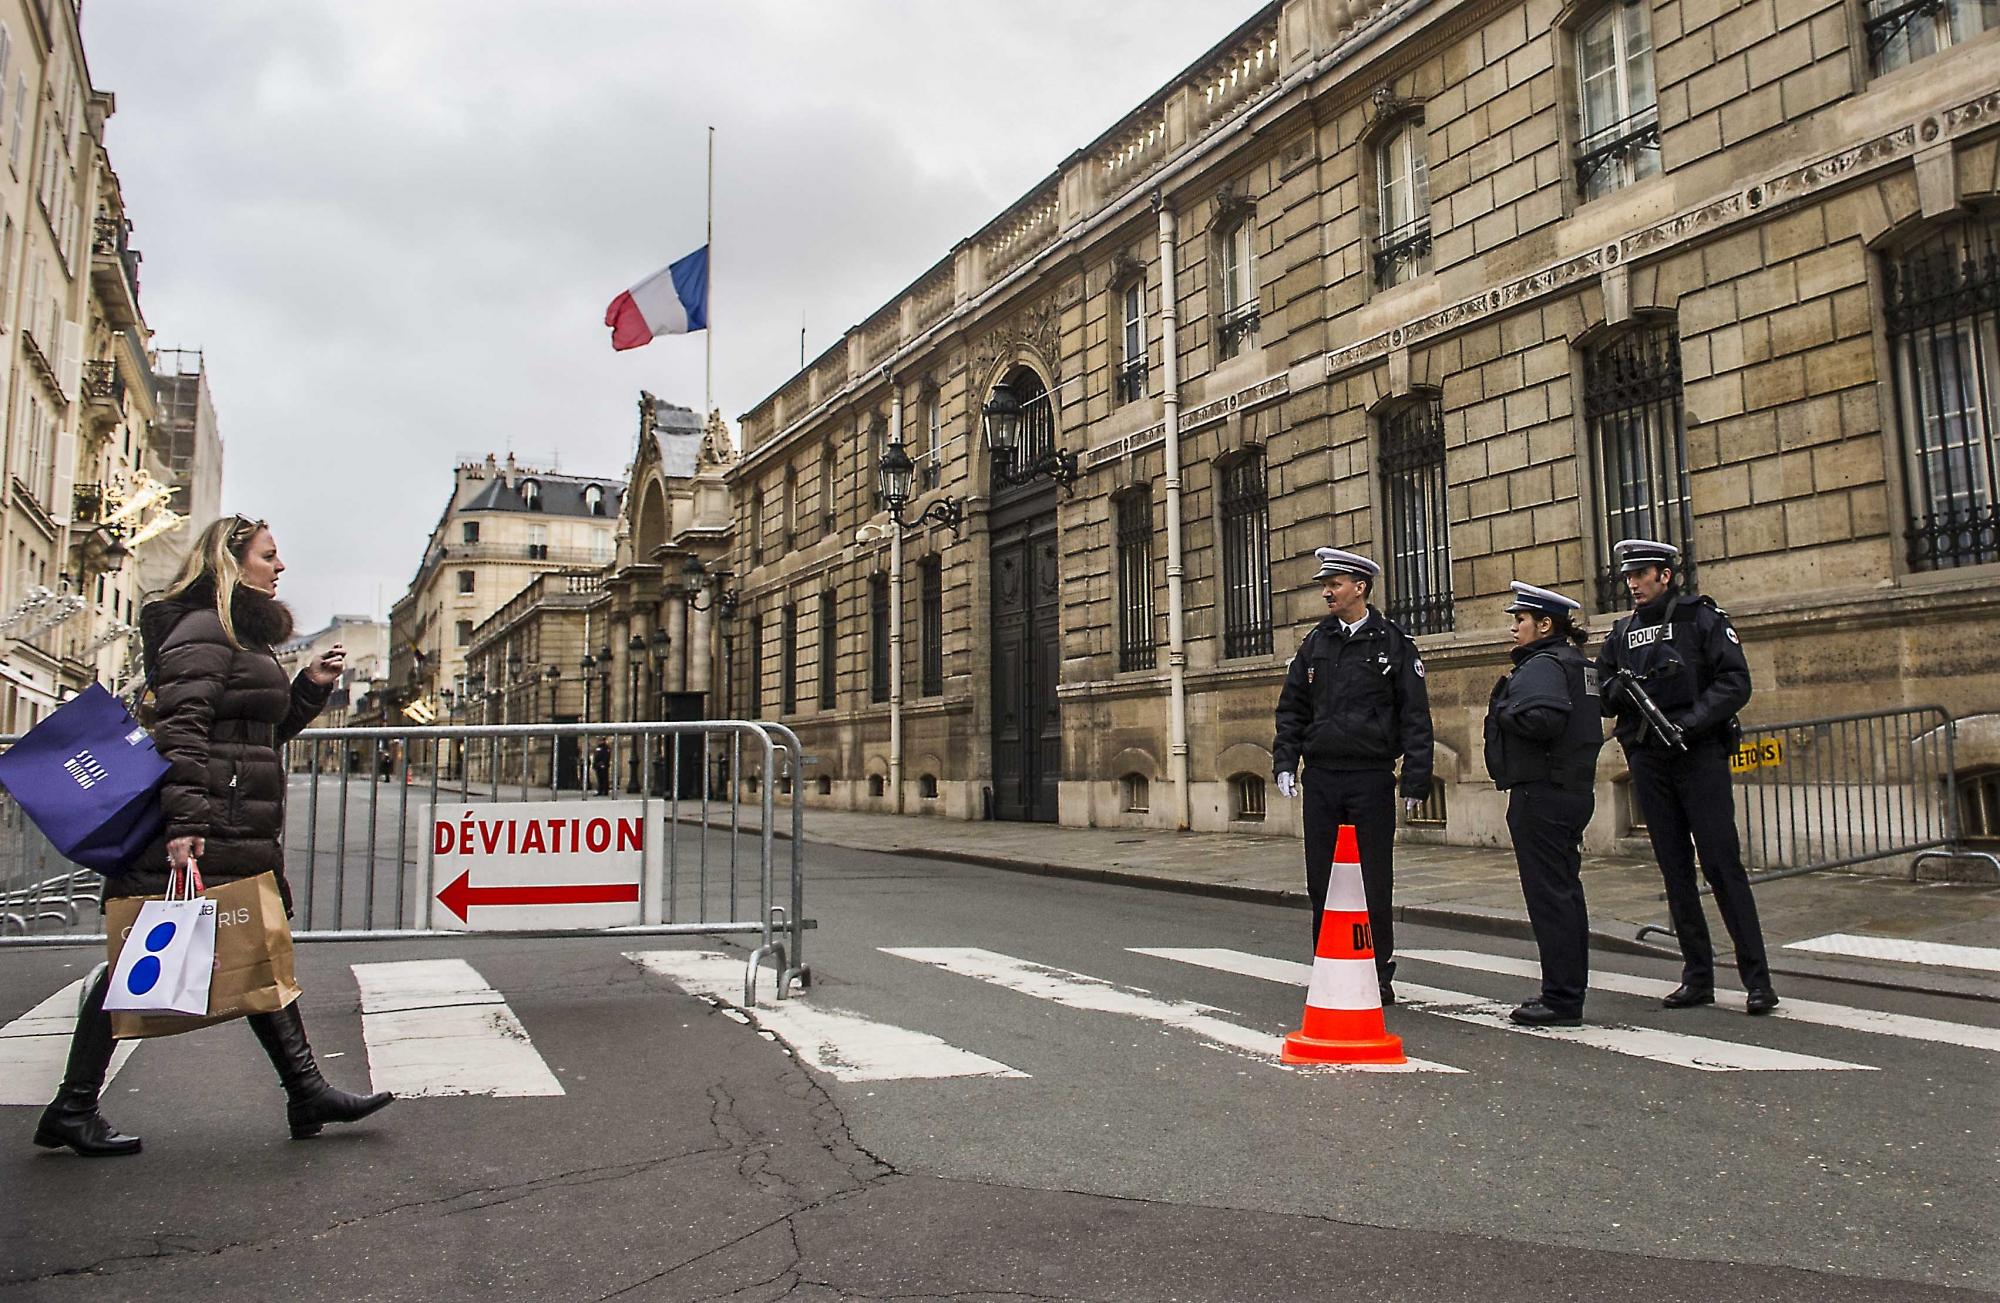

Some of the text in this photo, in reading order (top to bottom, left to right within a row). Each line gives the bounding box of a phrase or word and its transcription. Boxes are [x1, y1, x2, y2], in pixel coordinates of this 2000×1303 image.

[1732, 744, 1775, 768] IETONS
[434, 810, 644, 855] DÉVIATION
[218, 907, 250, 928] RIS
